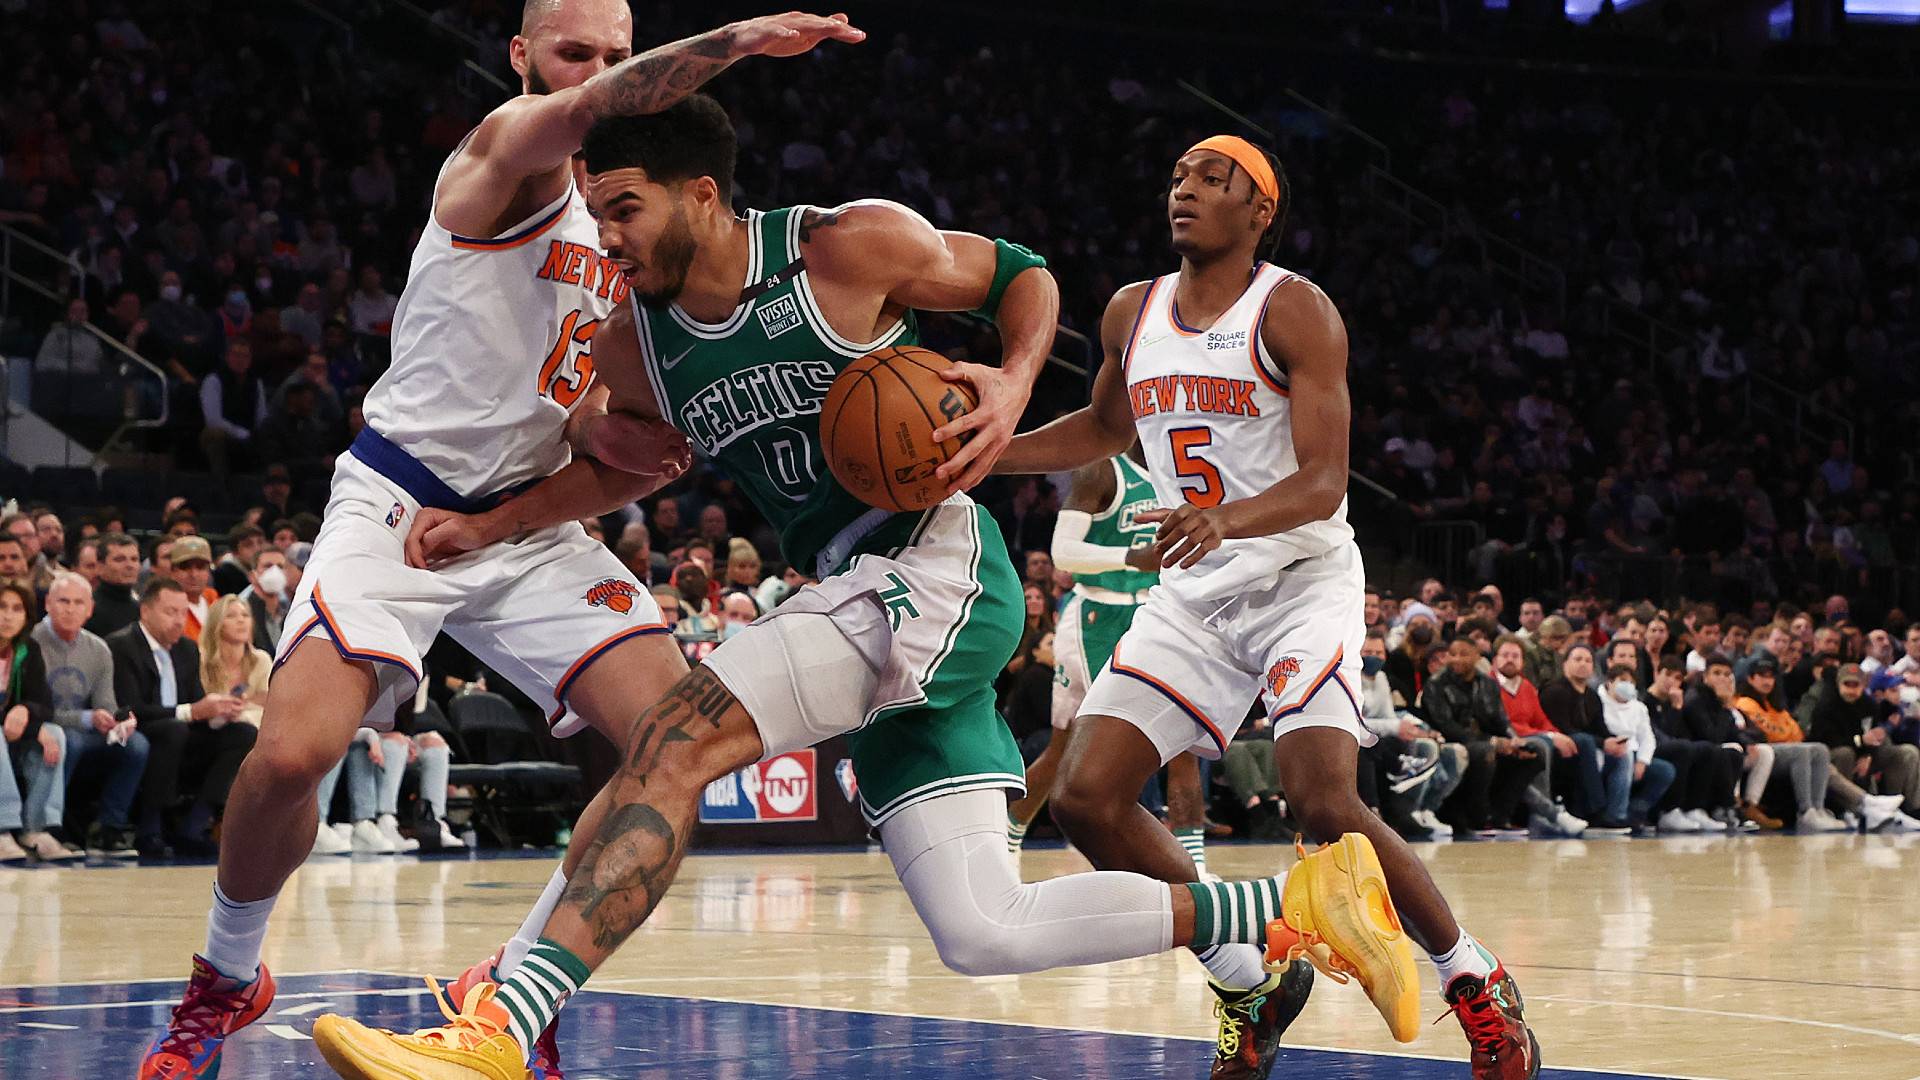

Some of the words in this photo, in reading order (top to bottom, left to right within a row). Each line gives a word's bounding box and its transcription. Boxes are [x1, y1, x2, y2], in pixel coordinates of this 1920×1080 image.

[538, 240, 598, 290] NEW
[766, 274, 780, 288] 24
[760, 299, 794, 323] VISTA
[767, 319, 789, 335] PRINT
[1207, 331, 1246, 342] SQUARE
[1207, 340, 1238, 350] SPACE
[680, 361, 837, 457] CELTICS
[1130, 374, 1179, 420] NEW
[1180, 374, 1260, 418] YORK
[753, 425, 818, 501] 0
[1168, 426, 1226, 509] 5
[879, 570, 922, 634] 75
[764, 777, 808, 798] TNT
